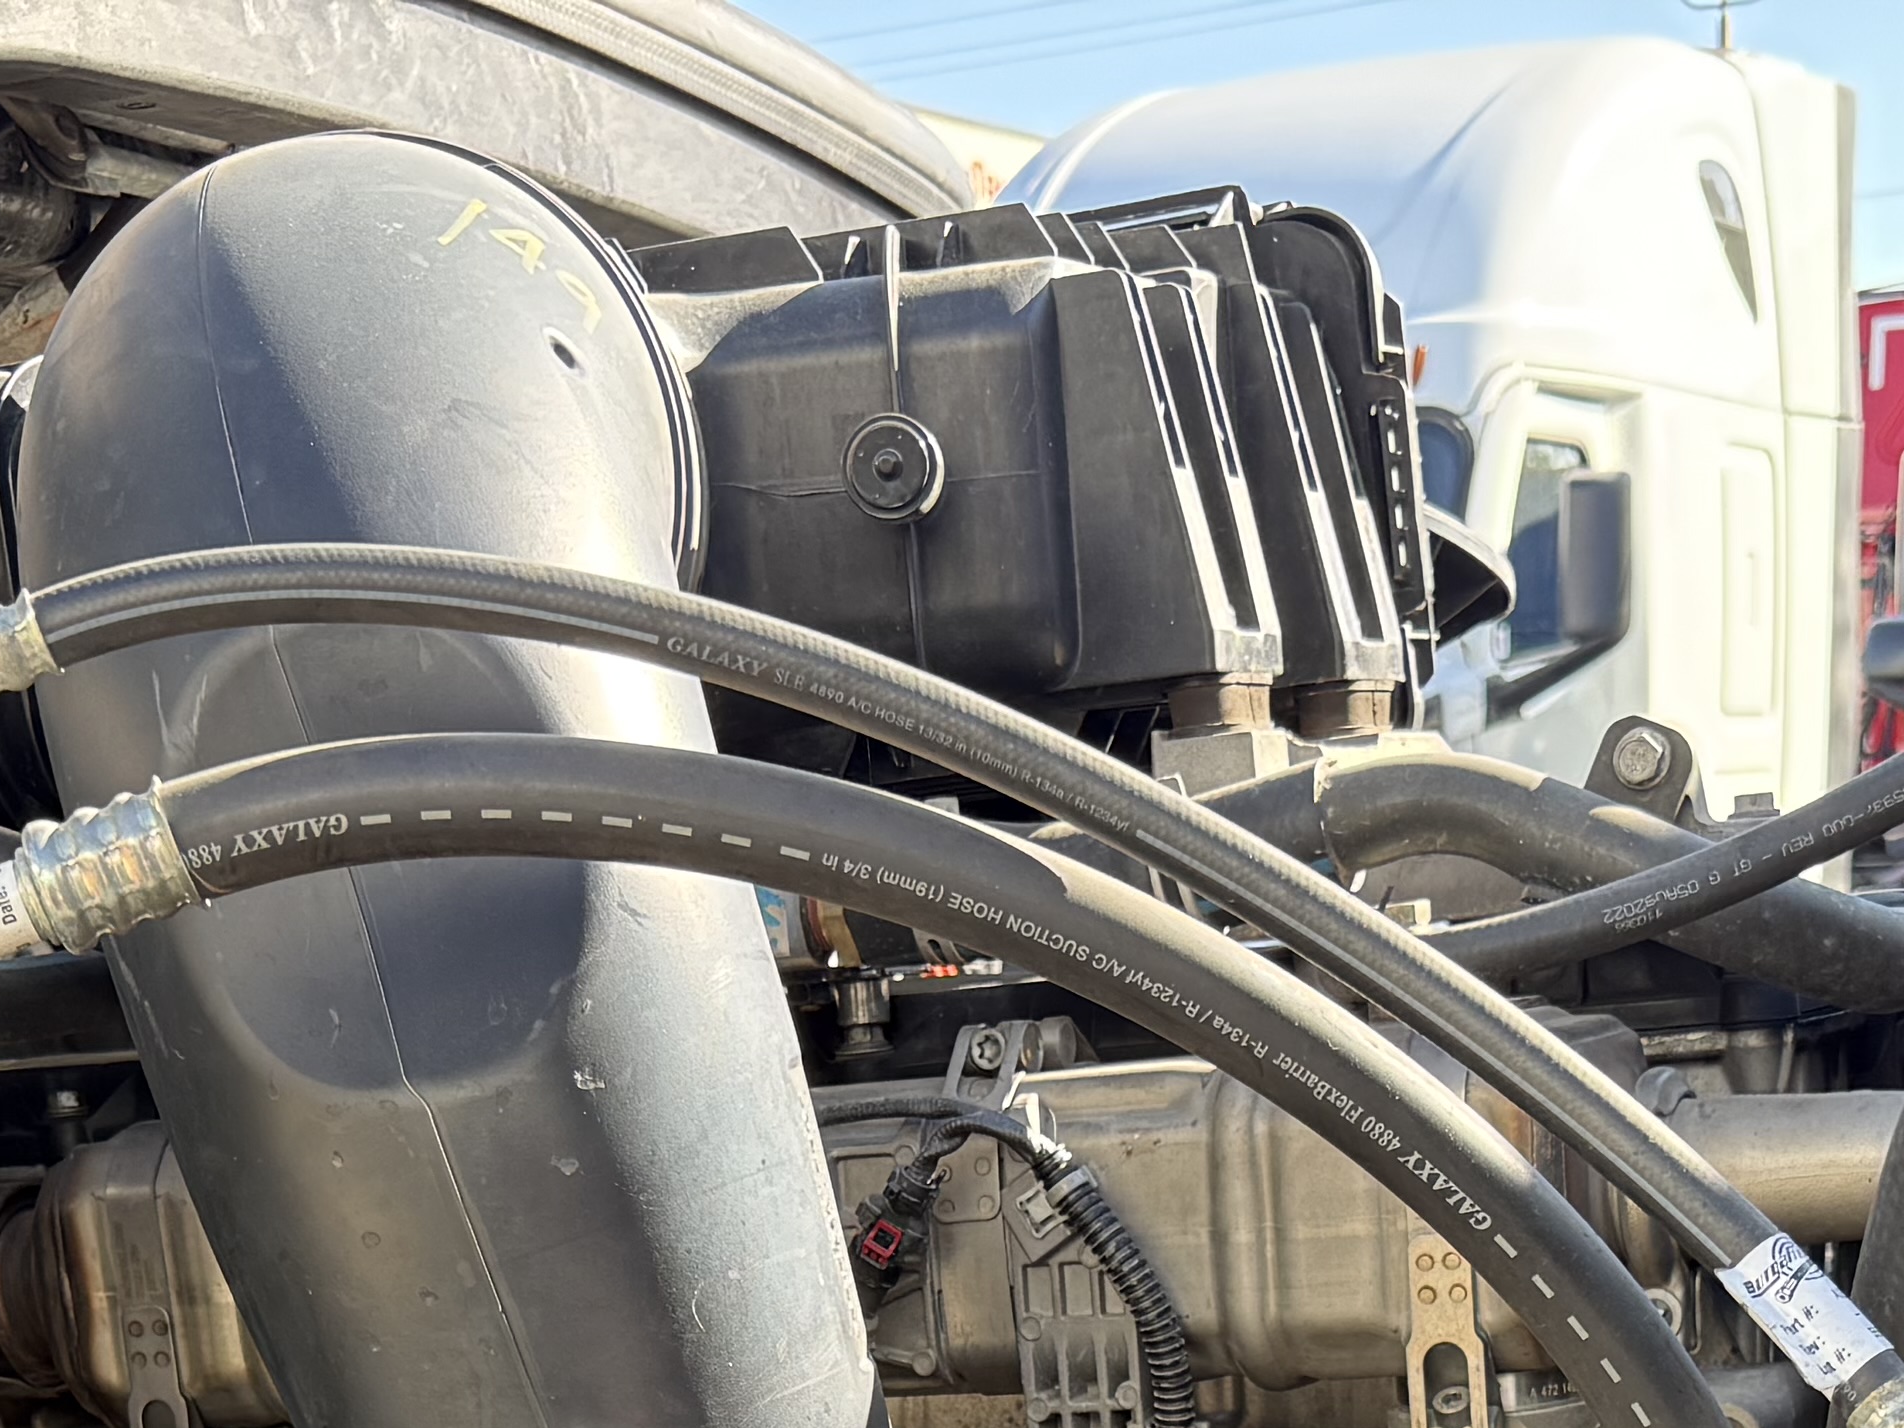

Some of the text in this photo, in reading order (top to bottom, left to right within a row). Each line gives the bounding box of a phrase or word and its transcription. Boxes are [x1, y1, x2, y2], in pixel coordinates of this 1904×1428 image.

[667, 636, 768, 677] GALAXY
[809, 683, 844, 703] 4890
[848, 698, 872, 714] A/C
[874, 706, 914, 731] HOSE
[918, 724, 953, 747] 13/32
[954, 740, 967, 753] in
[970, 747, 1018, 779] (10mm)
[1021, 769, 1064, 799] R-134a
[1075, 795, 1130, 832] R-1234yf
[231, 813, 349, 857] GALAXY
[821, 852, 840, 871] in
[843, 860, 872, 881] 3/4
[877, 866, 945, 901] (19mm)
[947, 892, 1004, 925] HOSE
[1005, 914, 1091, 962] SUCTION
[1091, 952, 1124, 979] A/C
[1124, 975, 1202, 1019] R-1234yf
[1212, 1015, 1269, 1059] R-134a
[1271, 1051, 1367, 1125] FlexBarrier
[1360, 1115, 1403, 1153] 4880
[1398, 1150, 1493, 1232] GALAXY
